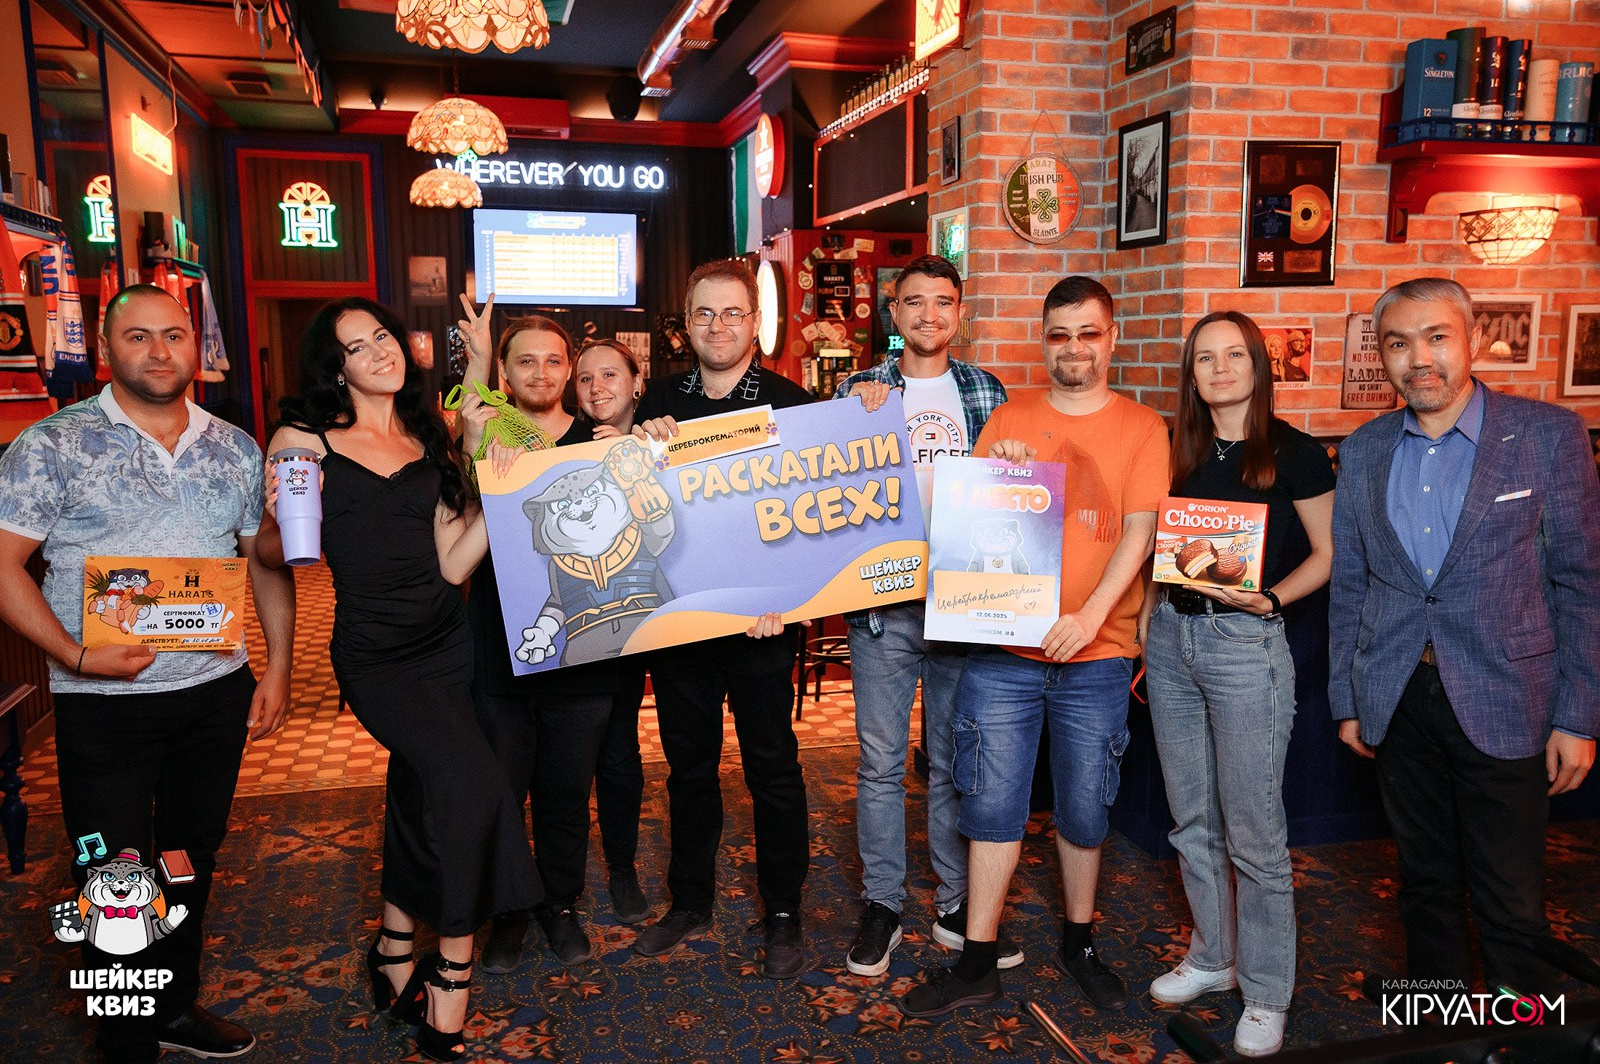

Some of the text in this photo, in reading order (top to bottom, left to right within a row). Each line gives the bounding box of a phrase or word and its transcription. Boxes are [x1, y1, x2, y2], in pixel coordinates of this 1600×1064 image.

[1423, 107, 1432, 117] 12
[578, 163, 625, 188] YOU
[633, 165, 665, 189] GO
[1019, 173, 1064, 185] IRISH PUB
[1352, 353, 1361, 362] NO
[1347, 392, 1392, 403] FREE DRINKS
[916, 414, 942, 423] YORK
[946, 423, 960, 444] CITY
[668, 425, 761, 452] ЦЕРЕБРОКРЕМАТОРИЙ
[677, 432, 901, 504] РАСКАТАЛИ
[1007, 467, 1033, 478] КВИЗ
[968, 484, 1051, 514] МЕСТО
[754, 477, 900, 543] ВСЕХ!
[1197, 504, 1227, 513] ORION
[1228, 538, 1260, 554] Original
[859, 555, 922, 580] ШЕЙКЕР
[872, 574, 914, 594] КВИЗ
[164, 618, 205, 630] 5000
